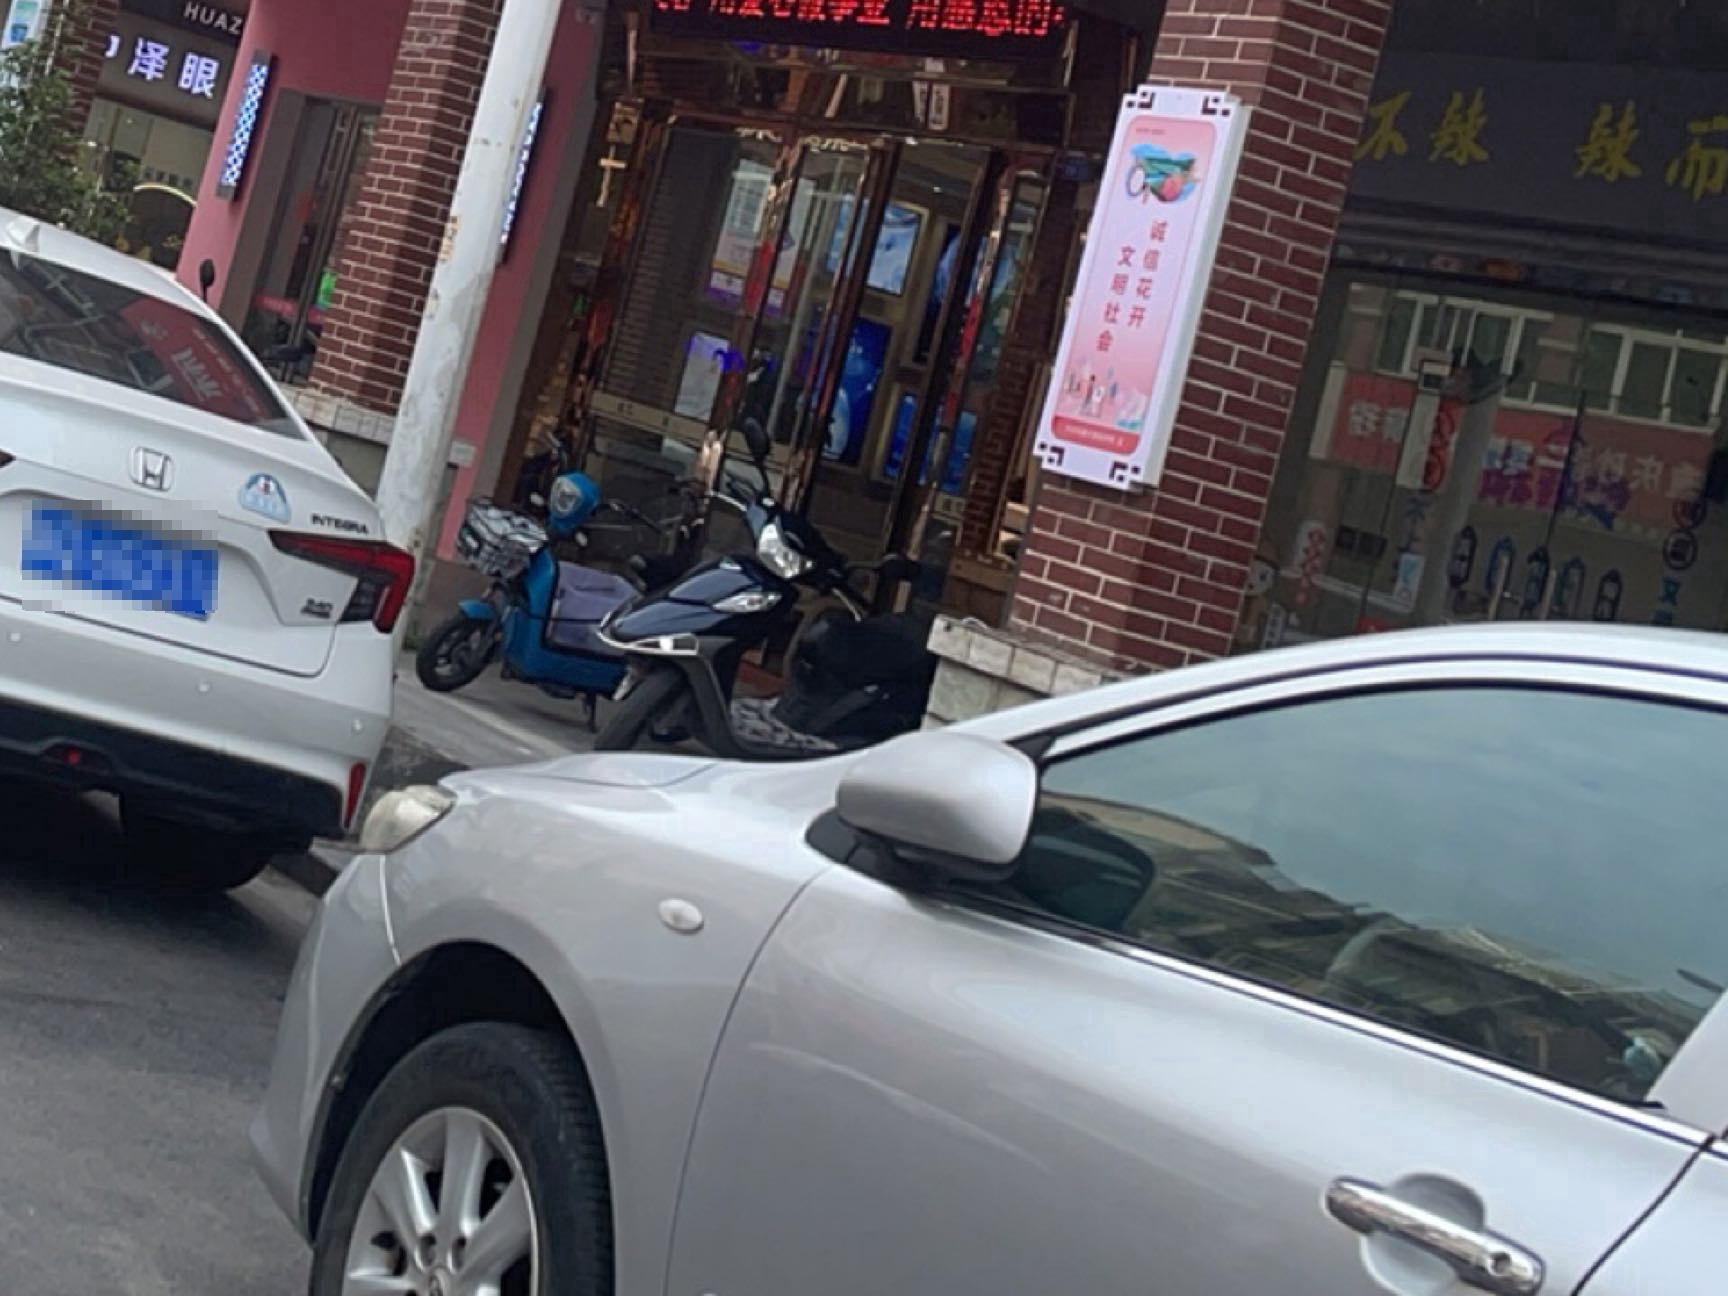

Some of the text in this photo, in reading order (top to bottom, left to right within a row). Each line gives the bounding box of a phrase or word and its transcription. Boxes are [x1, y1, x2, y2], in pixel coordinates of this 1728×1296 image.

[1095, 244, 1137, 354] 文明社会
[1127, 219, 1170, 329] 诚信花开
[310, 512, 370, 534] INTEGRA
